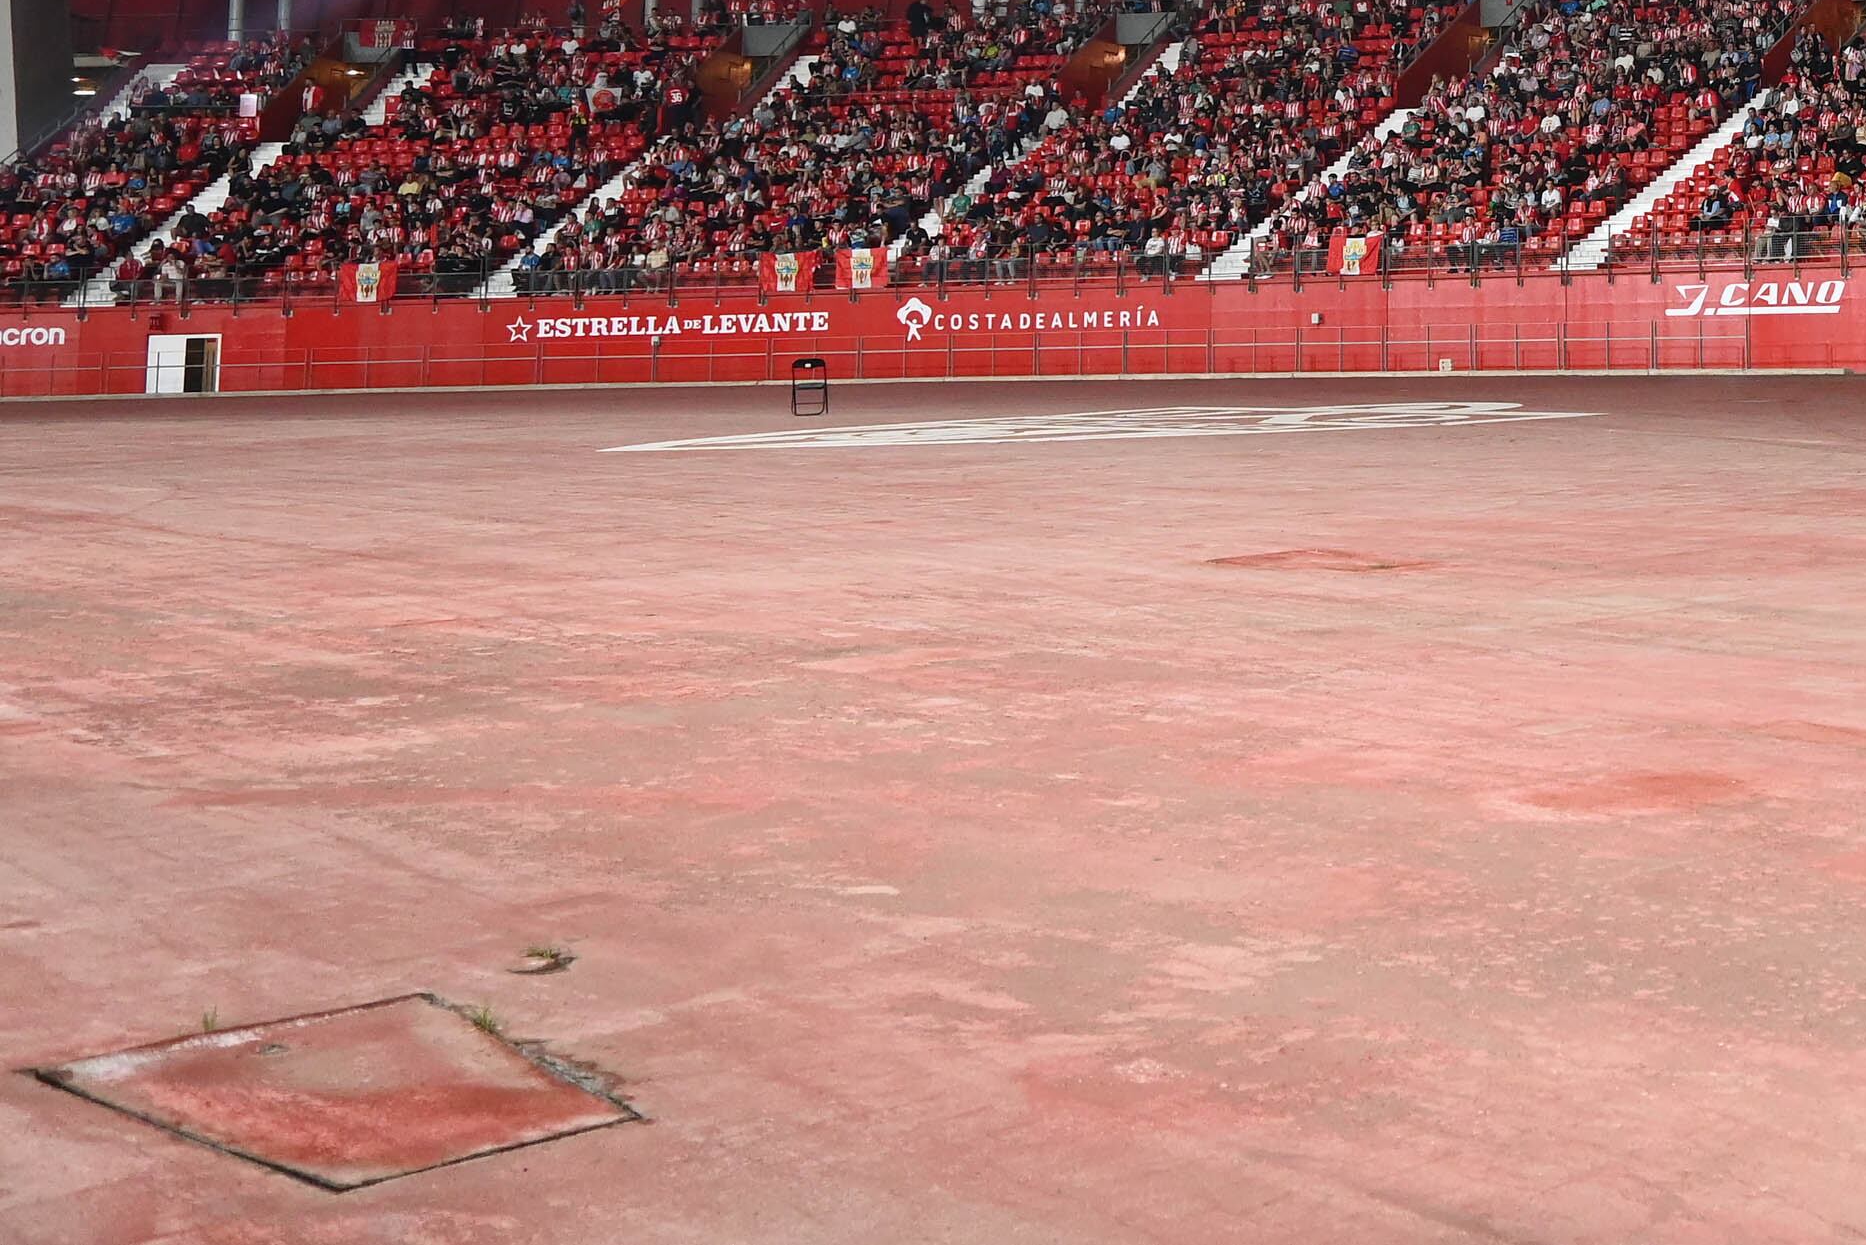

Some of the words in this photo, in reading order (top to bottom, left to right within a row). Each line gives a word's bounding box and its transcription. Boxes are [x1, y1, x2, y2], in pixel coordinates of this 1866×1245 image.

[536, 315, 681, 338] ESTRELLA
[701, 311, 829, 334] LEVANTE
[0, 327, 65, 345] cron
